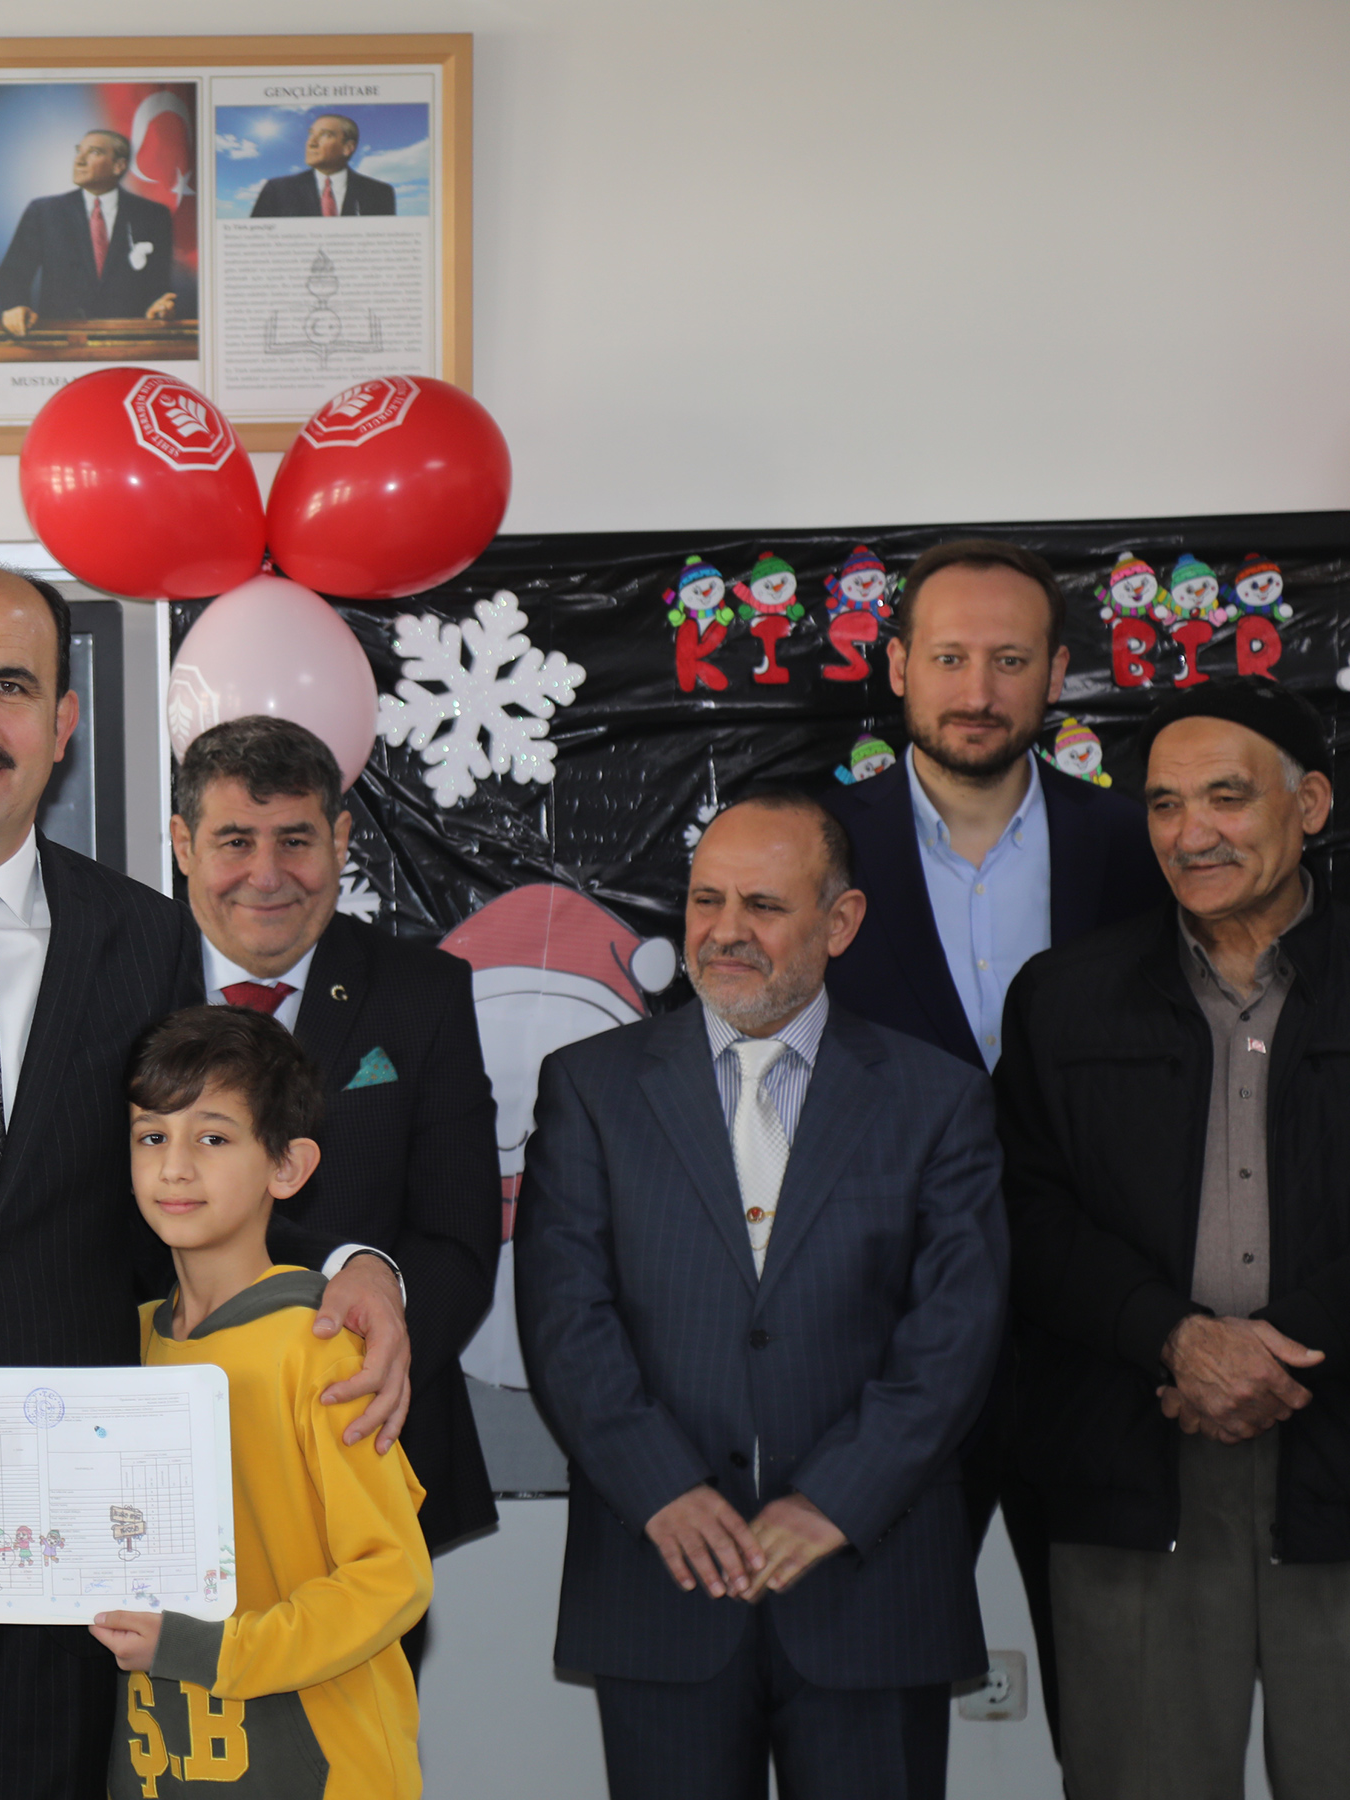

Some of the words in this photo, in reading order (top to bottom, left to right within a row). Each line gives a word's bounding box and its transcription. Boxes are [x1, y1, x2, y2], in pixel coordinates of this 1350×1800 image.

[264, 83, 330, 99] GENÇLİĞE
[333, 83, 380, 97] HİTABE
[11, 376, 69, 386] MUSTAFA
